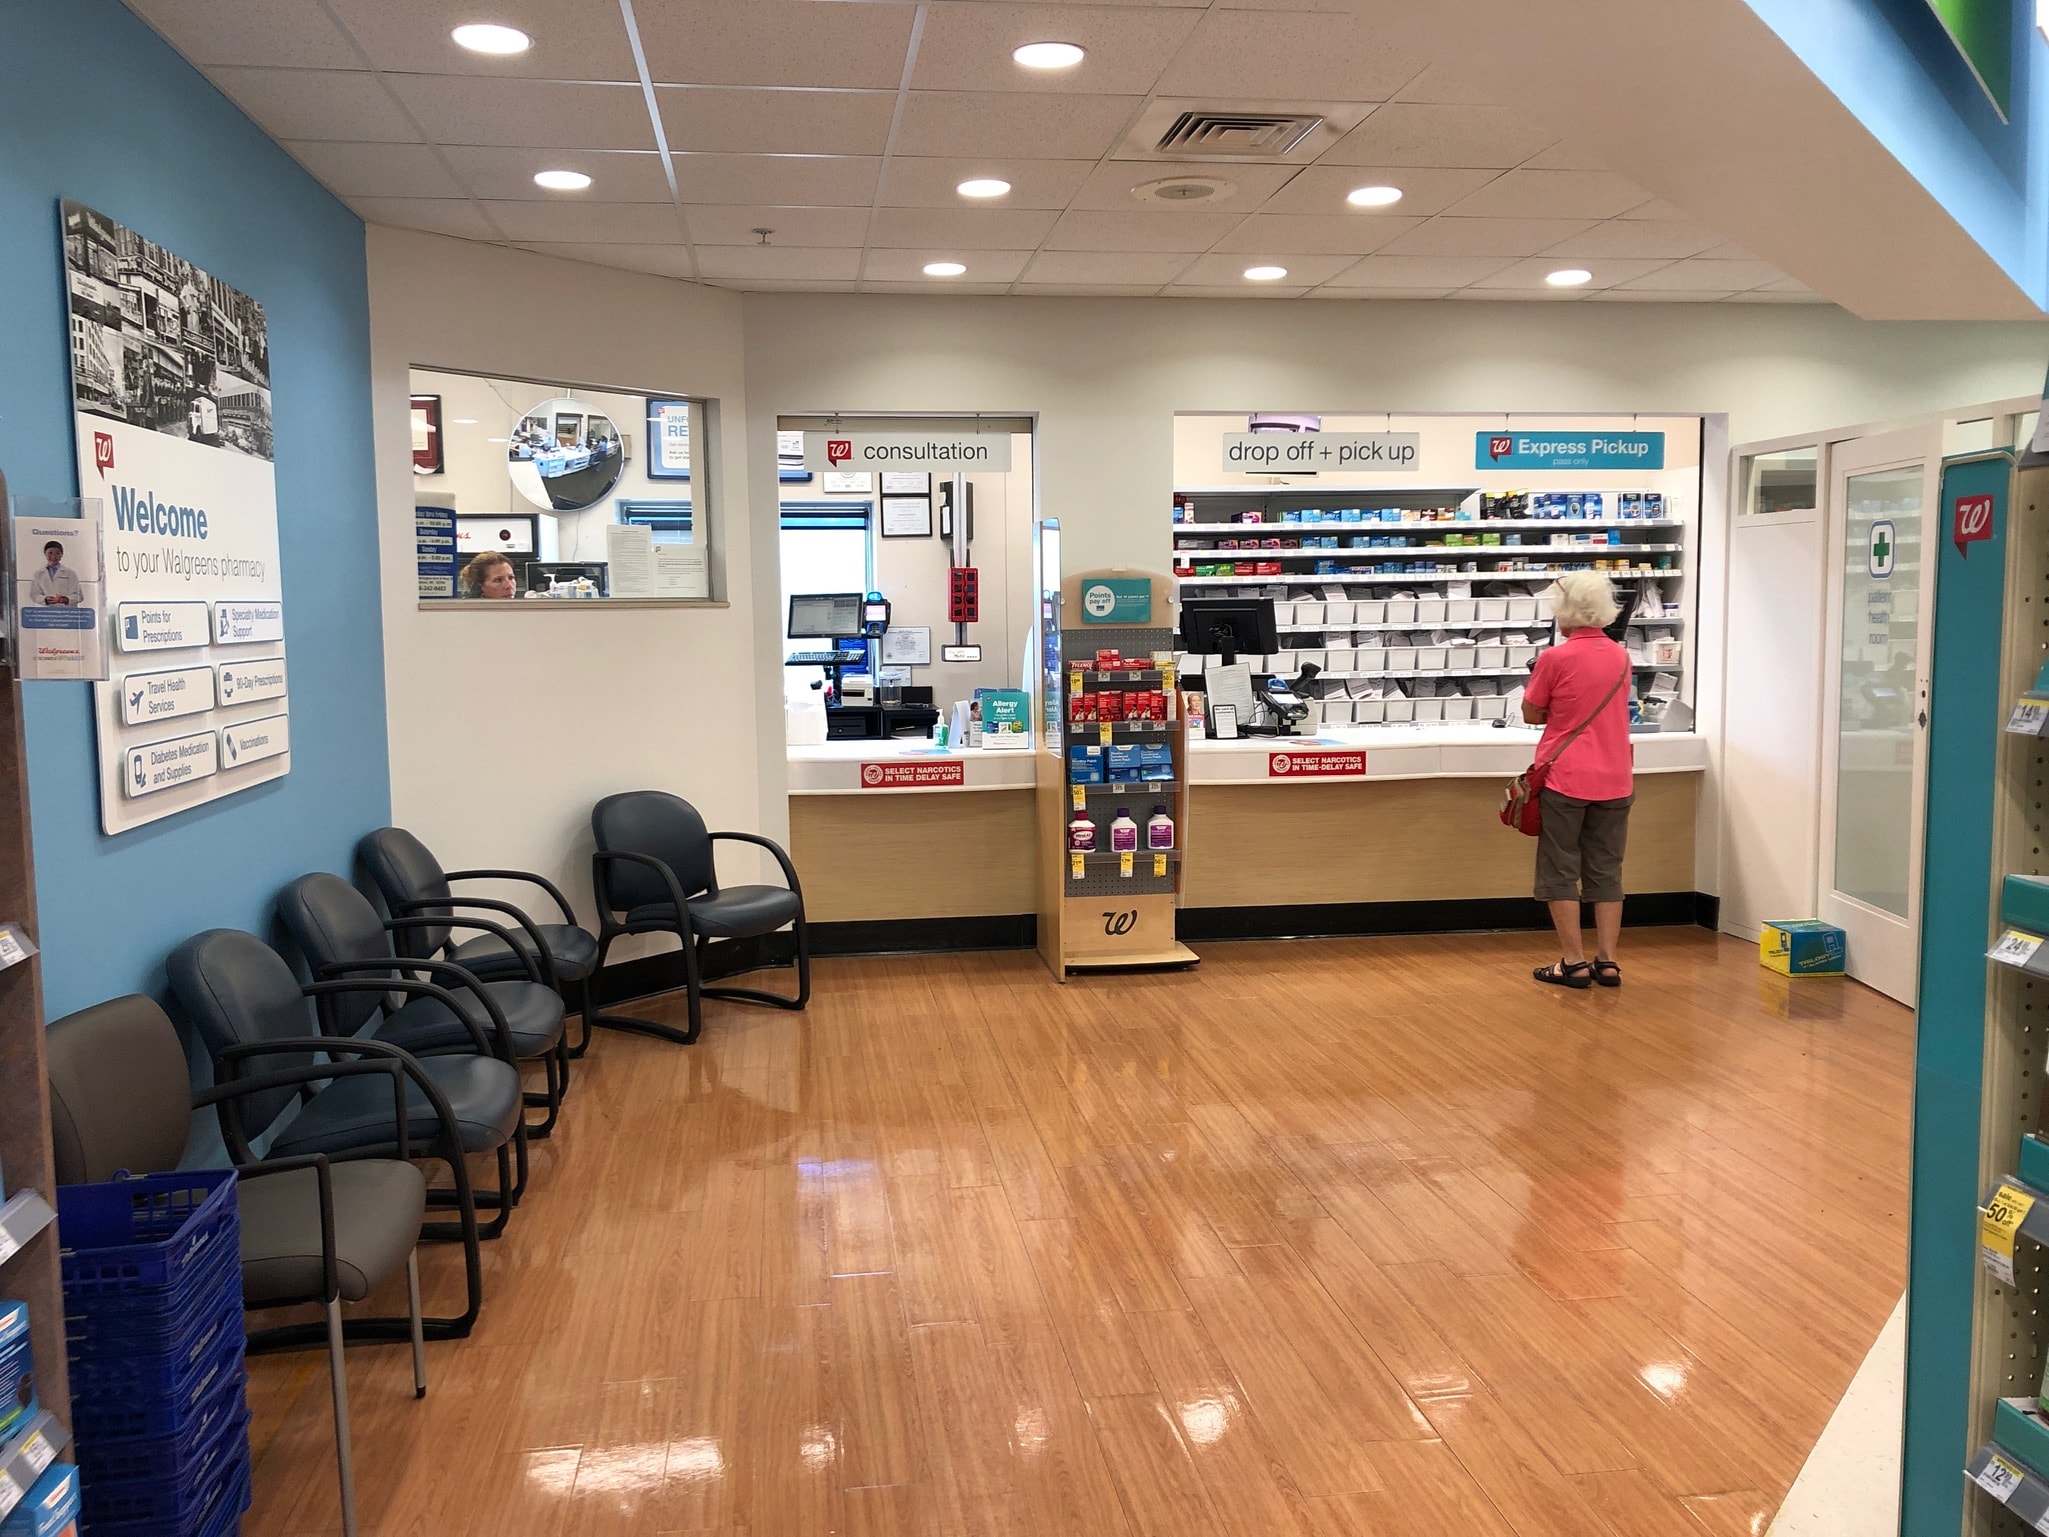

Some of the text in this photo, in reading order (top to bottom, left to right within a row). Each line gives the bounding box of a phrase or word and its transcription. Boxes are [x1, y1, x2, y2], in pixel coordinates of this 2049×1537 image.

[864, 442, 988, 460] consultation
[1229, 441, 1280, 465] drop
[1286, 441, 1315, 460] off
[1339, 441, 1383, 465] pick
[1388, 445, 1415, 465] up
[1518, 438, 1586, 457] Express
[1591, 438, 1649, 457] Pickup
[1553, 457, 1589, 467] pass only
[112, 485, 208, 540] Welcome
[32, 528, 79, 537] Questions?
[117, 546, 265, 583] to your Walgreens pharmacy
[141, 610, 171, 624] Points for
[232, 609, 279, 622] Specialty Medication
[143, 630, 182, 645] Prescriptions
[232, 625, 253, 638] Support
[147, 677, 186, 695] Travel Health
[254, 673, 283, 688] Prescriptions
[148, 699, 175, 715] Services
[239, 734, 269, 751] Vaccinations
[151, 741, 209, 765] Diabetes Medication
[1321, 756, 1362, 764] NARCOTICS
[153, 763, 192, 784] and Supplies
[885, 767, 915, 775] SELECT
[916, 766, 961, 774] NARCOTICS
[1302, 763, 1343, 771] TIME-DELAY
[885, 772, 961, 782] IN TIME DELAY SAFE
